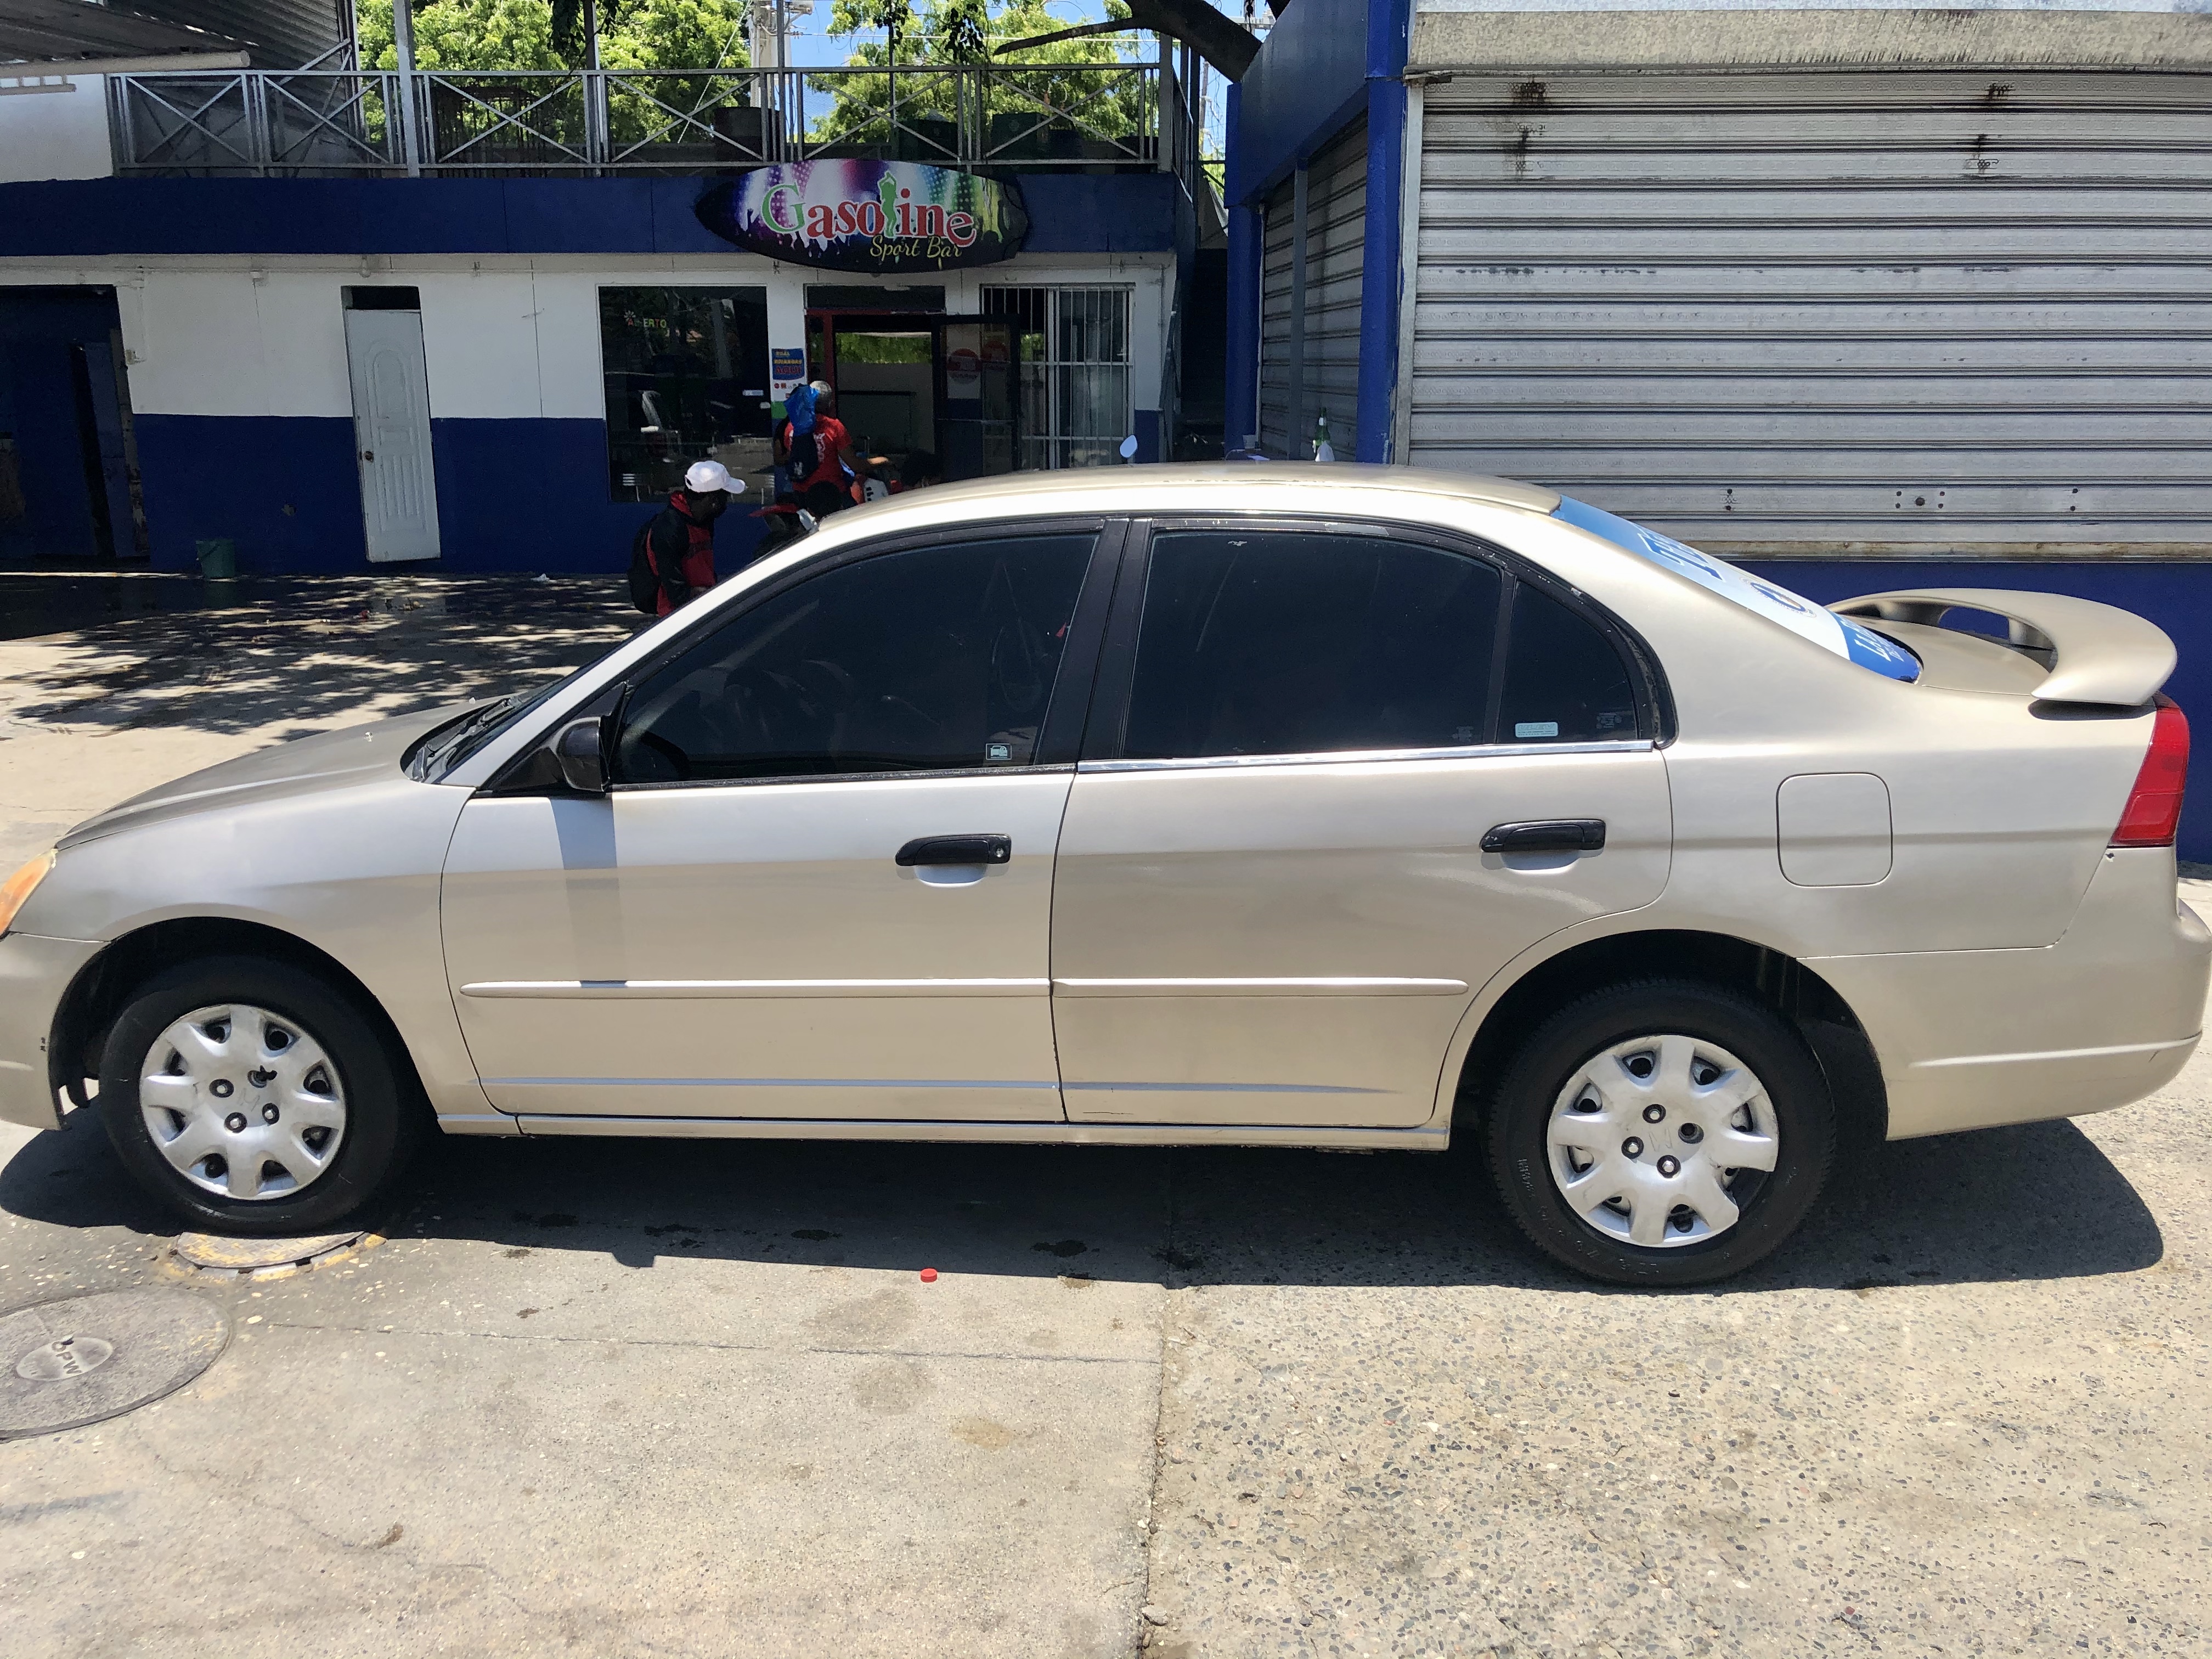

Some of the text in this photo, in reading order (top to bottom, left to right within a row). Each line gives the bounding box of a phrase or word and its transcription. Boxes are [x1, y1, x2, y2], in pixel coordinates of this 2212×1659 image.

[760, 172, 977, 247] Gasoline
[870, 234, 962, 262] Sport Bar
[52, 1341, 82, 1374] OPW
